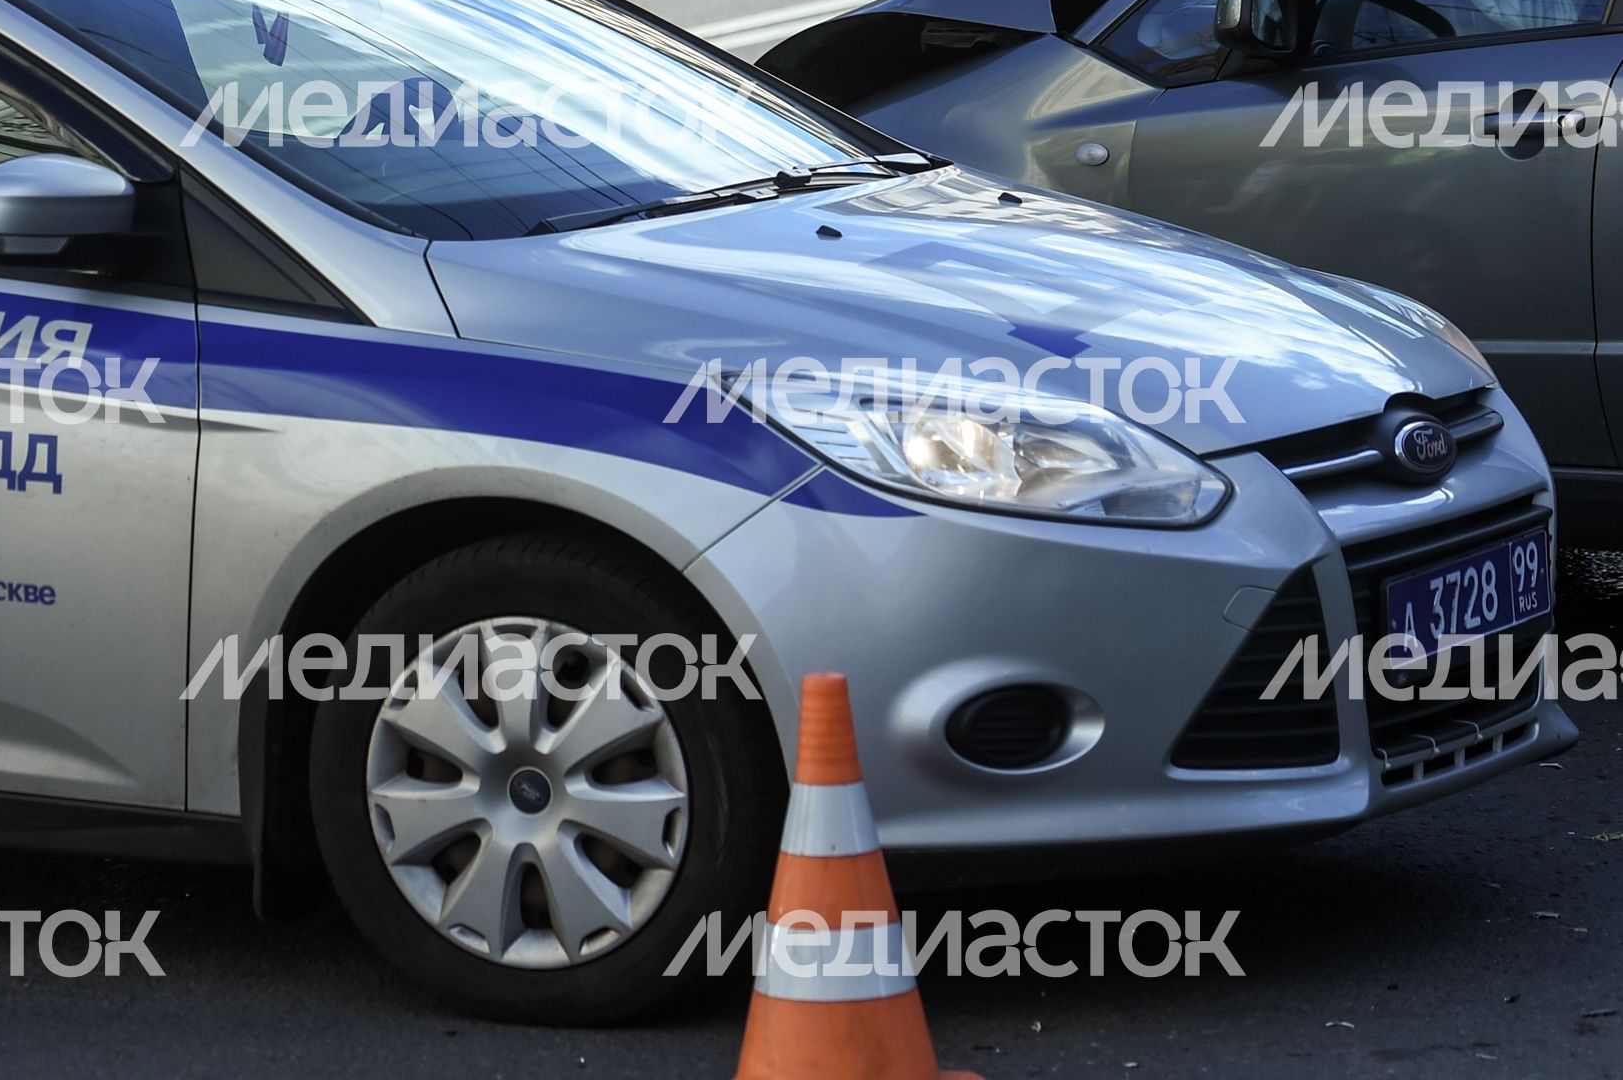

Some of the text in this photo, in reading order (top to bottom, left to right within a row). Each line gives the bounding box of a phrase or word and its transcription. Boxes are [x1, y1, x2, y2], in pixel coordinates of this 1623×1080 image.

[1413, 428, 1448, 460] Ford
[1512, 540, 1538, 593] 99
[1429, 560, 1499, 640] 3728
[1518, 591, 1539, 614] RUS
